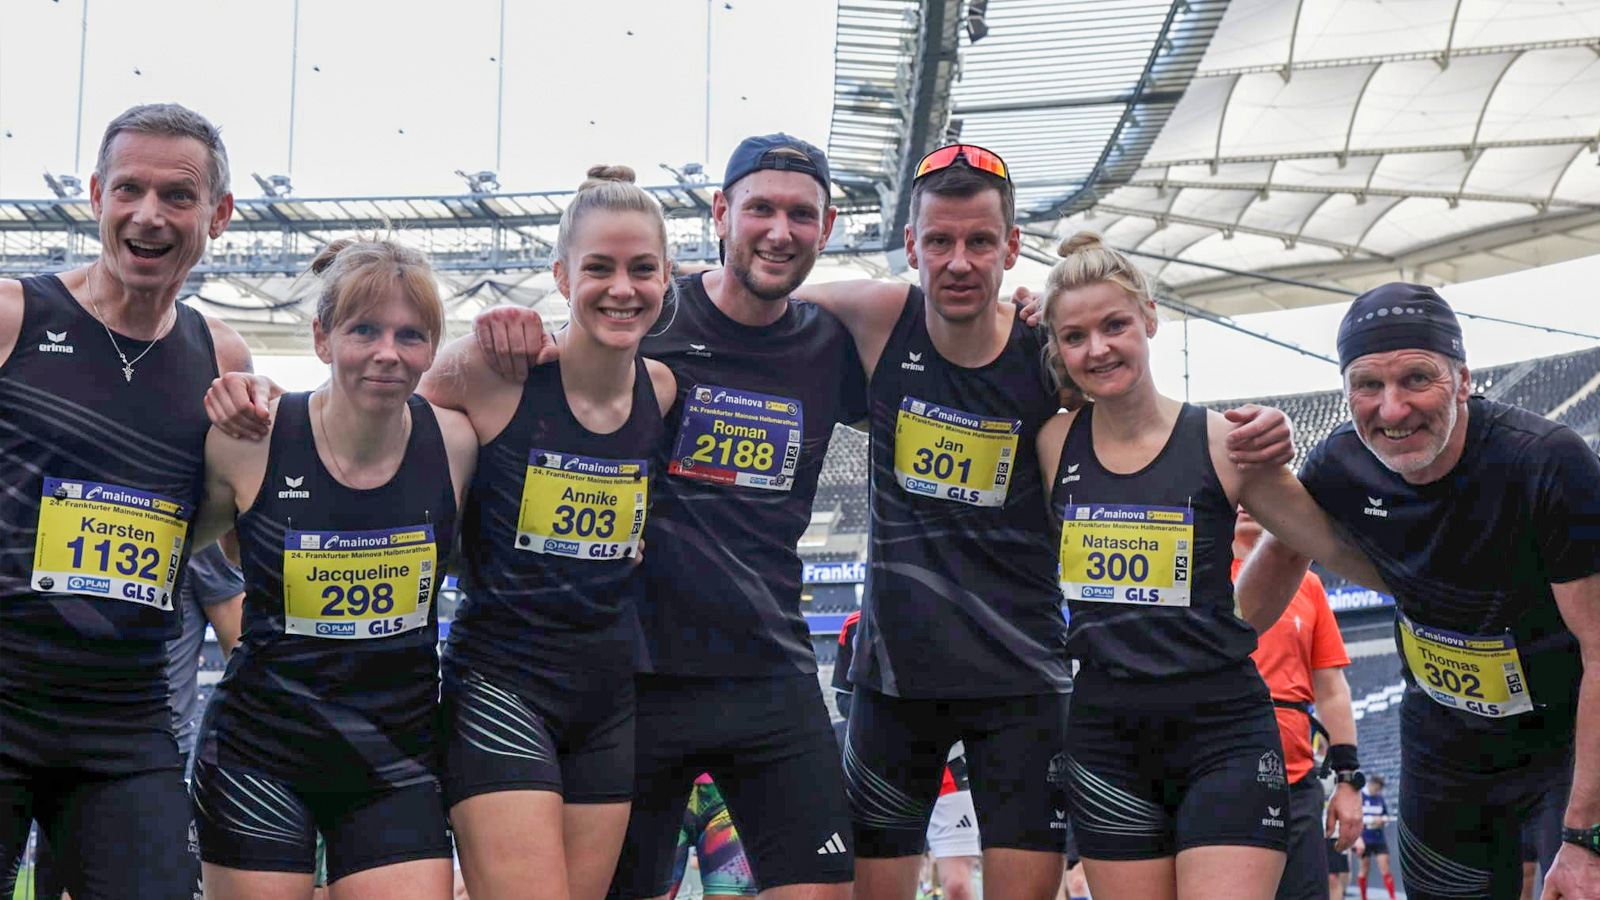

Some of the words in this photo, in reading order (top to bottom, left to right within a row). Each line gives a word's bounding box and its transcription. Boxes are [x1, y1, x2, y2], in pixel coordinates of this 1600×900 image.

[39, 343, 74, 353] erima
[901, 362, 925, 371] erima
[725, 395, 763, 408] mainova
[938, 411, 979, 428] mainova
[713, 419, 767, 440] Roman
[692, 434, 775, 471] 2188
[934, 436, 964, 453] Jan
[578, 463, 618, 474] mainova
[913, 447, 972, 484] 301
[546, 470, 586, 481] Frankfurter
[102, 490, 151, 507] mainova
[278, 489, 310, 499] erima
[561, 487, 618, 506] Annike
[49, 499, 63, 507] 24.
[65, 501, 111, 512] Frankfurter
[113, 507, 143, 518] Mainova
[1104, 510, 1145, 519] mainova
[1364, 507, 1388, 517] erima
[80, 517, 155, 543] Karsten
[552, 505, 616, 539] 303
[1140, 524, 1187, 532] Halbmarathon
[340, 533, 388, 548] mainova
[558, 543, 579, 551] PLAN
[1082, 534, 1159, 551] Natascha
[67, 536, 160, 581] 1132
[351, 551, 382, 559] Mainova
[383, 546, 431, 557] Halbmarathon
[306, 564, 410, 584] Jacqueline
[1086, 551, 1149, 583] 300
[86, 579, 109, 589] PLAN
[1094, 587, 1113, 595] PLAN
[320, 582, 394, 616] 298
[332, 624, 354, 633] PLAN
[1424, 631, 1465, 647] mainova
[1418, 646, 1481, 673] Thomas
[1424, 662, 1485, 699] 302
[1262, 818, 1285, 828] erima
